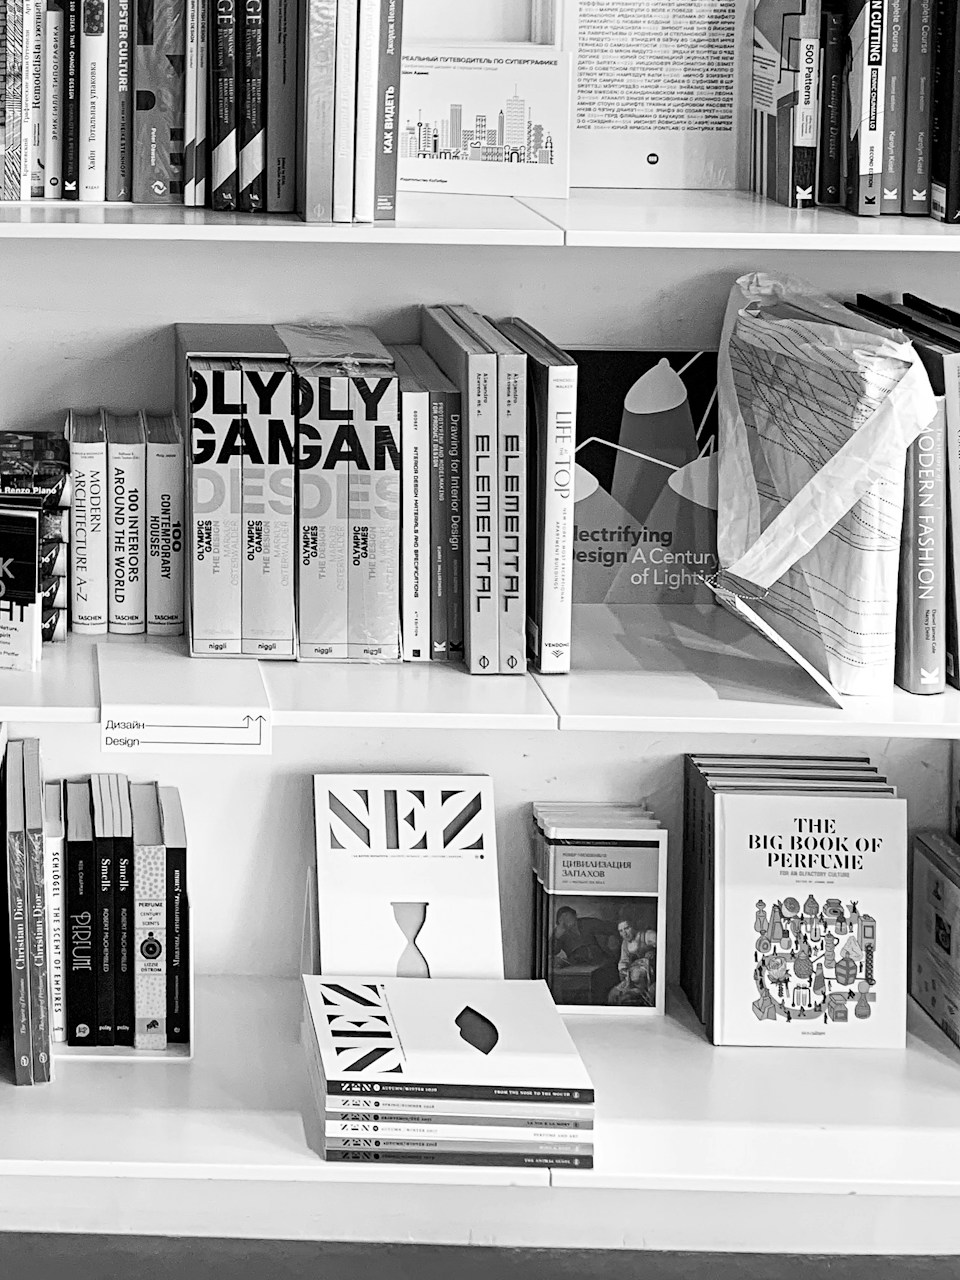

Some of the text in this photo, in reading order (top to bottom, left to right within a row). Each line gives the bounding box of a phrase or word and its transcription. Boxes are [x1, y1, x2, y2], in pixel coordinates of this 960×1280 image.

[869, 11, 882, 63] CUTTING
[117, 40, 128, 93] CULTURE
[803, 44, 815, 106] 500 Patterns
[383, 85, 396, 154] КАК ВИДЕТЬ
[114, 467, 125, 603] AROUND THE WORLD
[128, 488, 139, 583] 100 INTERIORS
[149, 515, 160, 557] HOUSES
[160, 494, 171, 580] CONTEMPORARY
[172, 520, 182, 553] 100
[475, 434, 491, 613] ELEMENTAL
[504, 434, 520, 613] ELEMENTAL
[104, 720, 145, 730] Дизайн
[104, 736, 140, 748] Design
[328, 789, 484, 850] NEZ
[749, 834, 883, 853] BIG BOOK OF
[793, 818, 836, 834] THE
[768, 853, 863, 870] PERFUME
